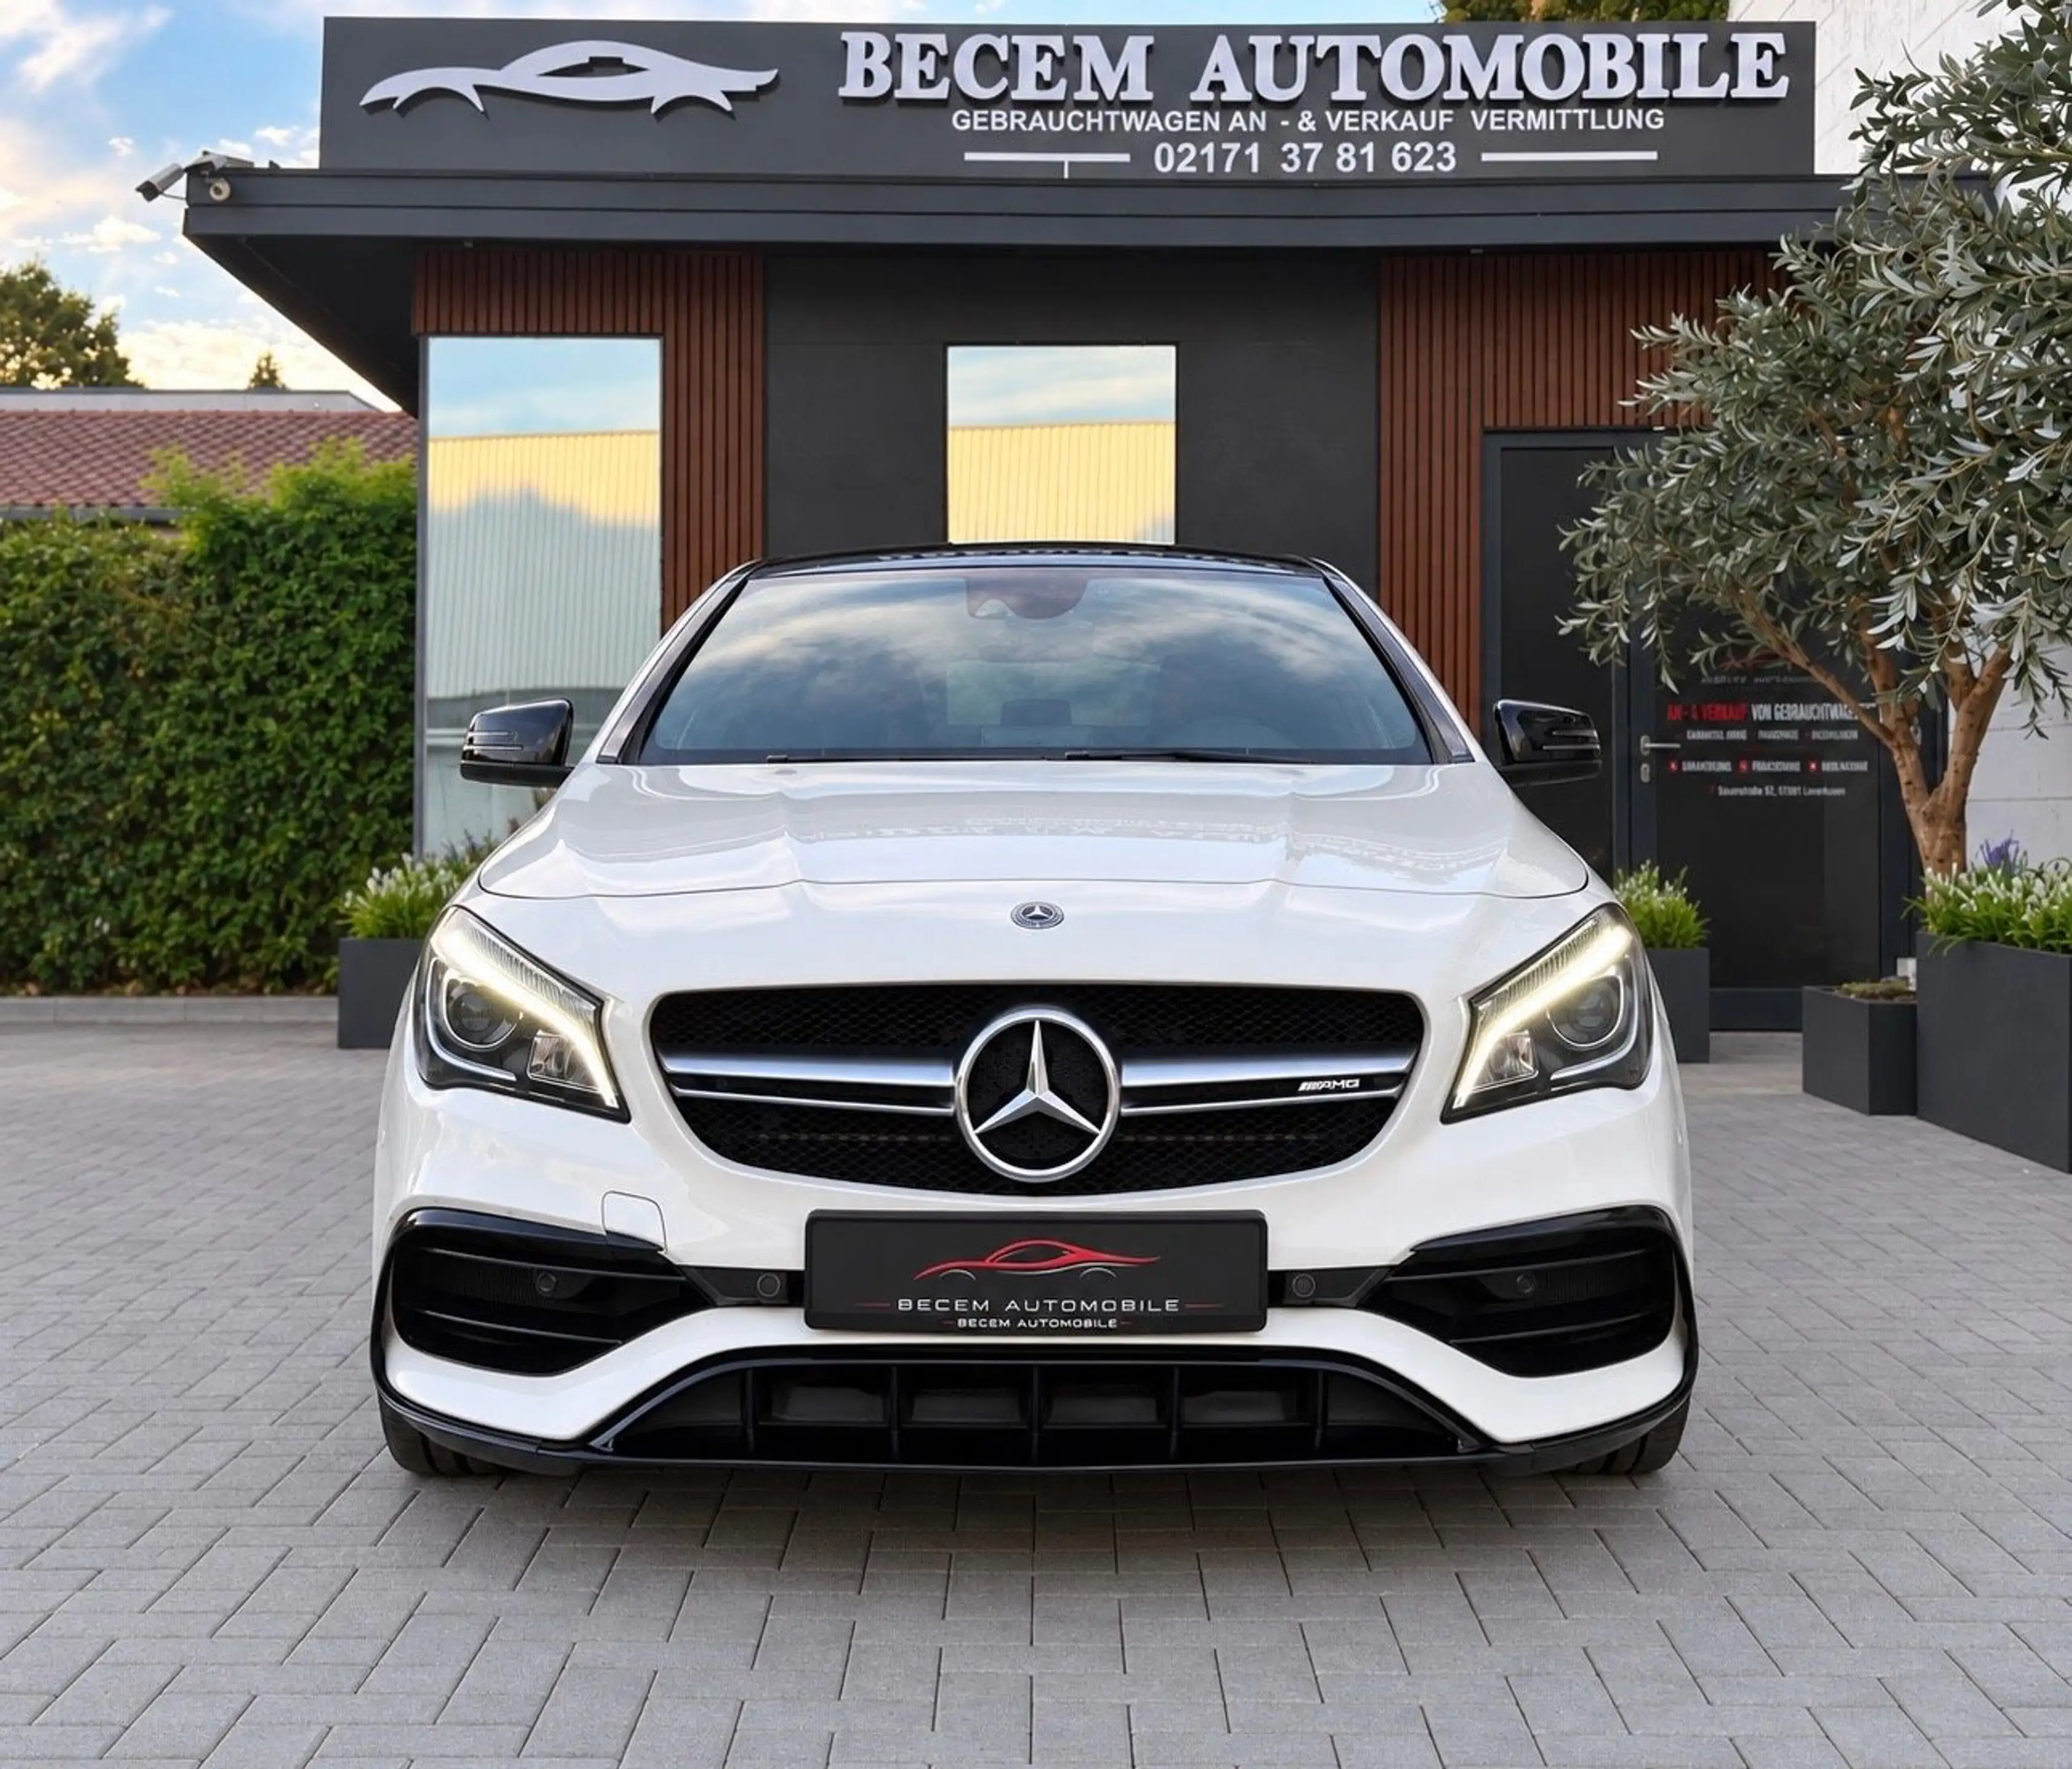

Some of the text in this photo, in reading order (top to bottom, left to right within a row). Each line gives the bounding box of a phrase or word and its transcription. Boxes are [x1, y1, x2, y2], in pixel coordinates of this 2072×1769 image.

[837, 31, 1790, 102] BECEM AUTOMOBILE
[952, 109, 1221, 133] GEBRAUCHTWAGEN
[1228, 110, 1267, 133] AN
[1297, 109, 1316, 133] &
[1324, 109, 1455, 132] VERKAUF
[1469, 108, 1665, 131] VERMITTLUNG
[1154, 141, 1456, 174] 02171 37 81 623
[897, 1298, 1179, 1313] BECEM AUTOMOBILE
[956, 1318, 1117, 1329] BECEM AUTOMOBILE
